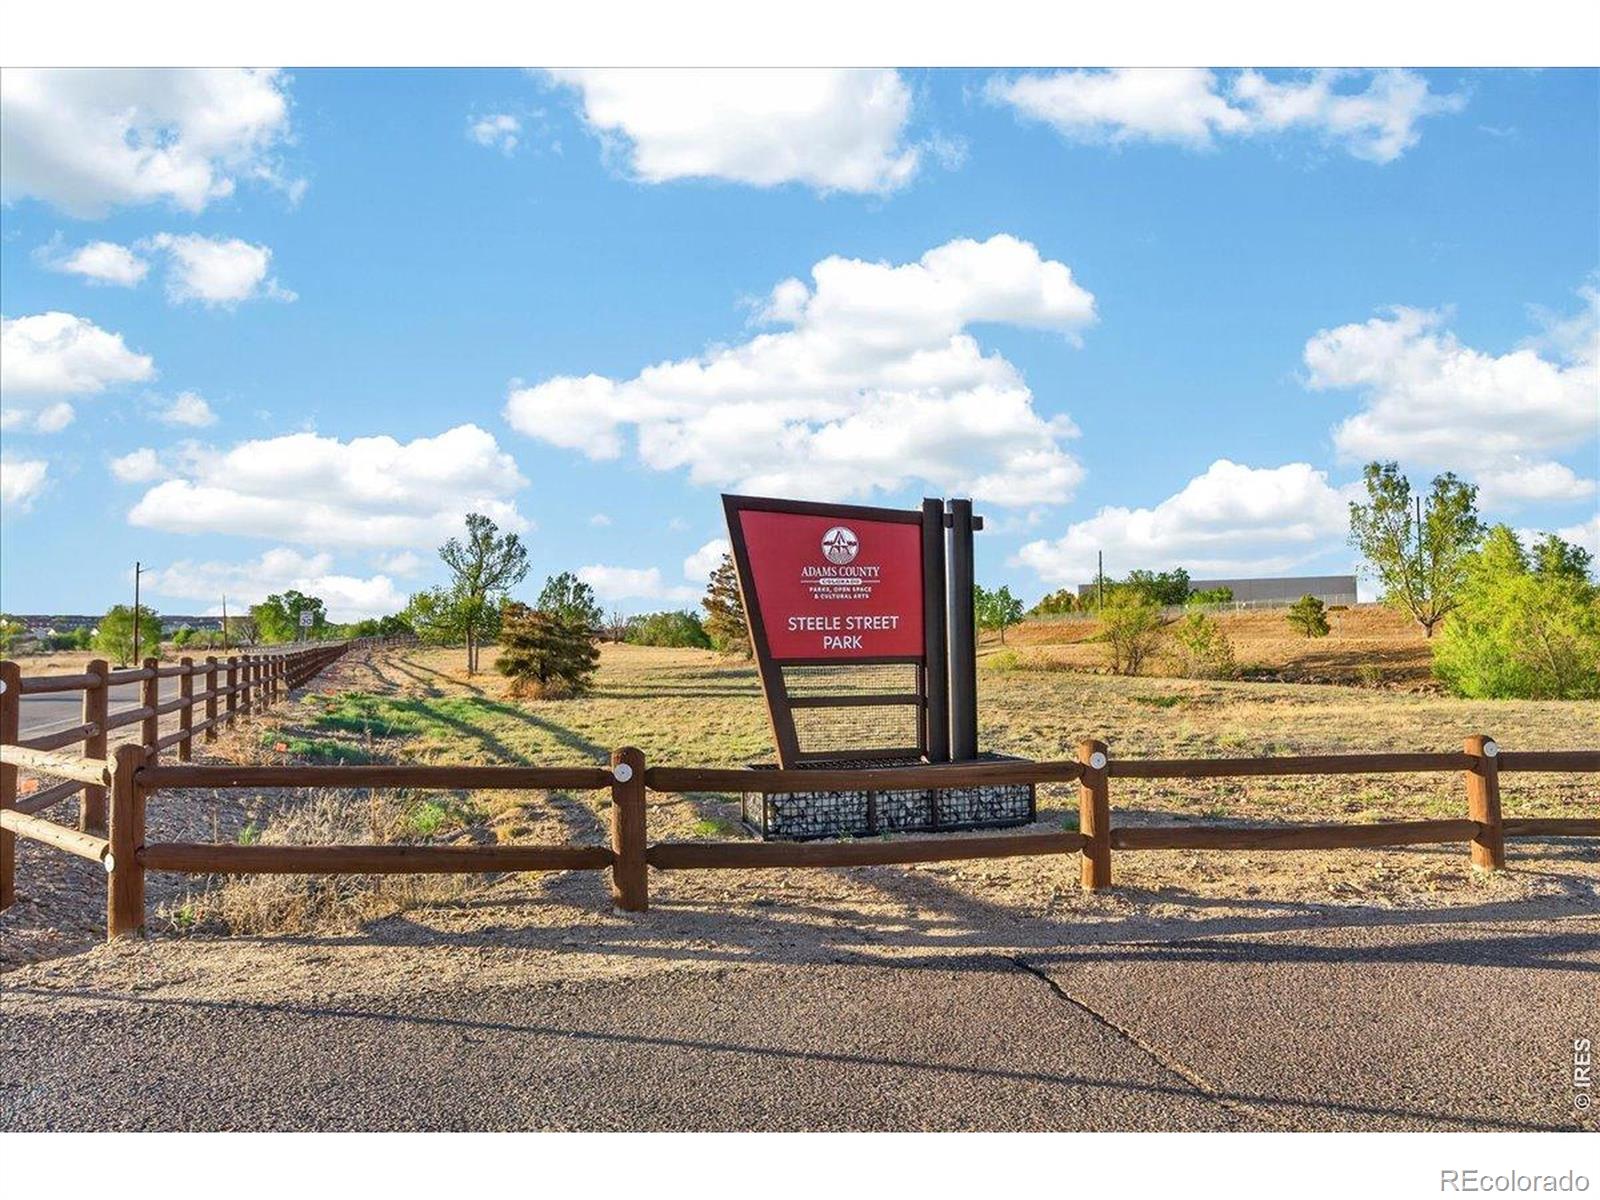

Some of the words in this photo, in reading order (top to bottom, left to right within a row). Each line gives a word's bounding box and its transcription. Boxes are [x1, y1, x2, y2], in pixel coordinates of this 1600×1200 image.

[801, 566, 837, 577] ADAMS
[839, 566, 880, 577] COUNTY
[788, 616, 841, 631] STEELE
[846, 615, 899, 630] STREET
[823, 635, 863, 649] PARK
